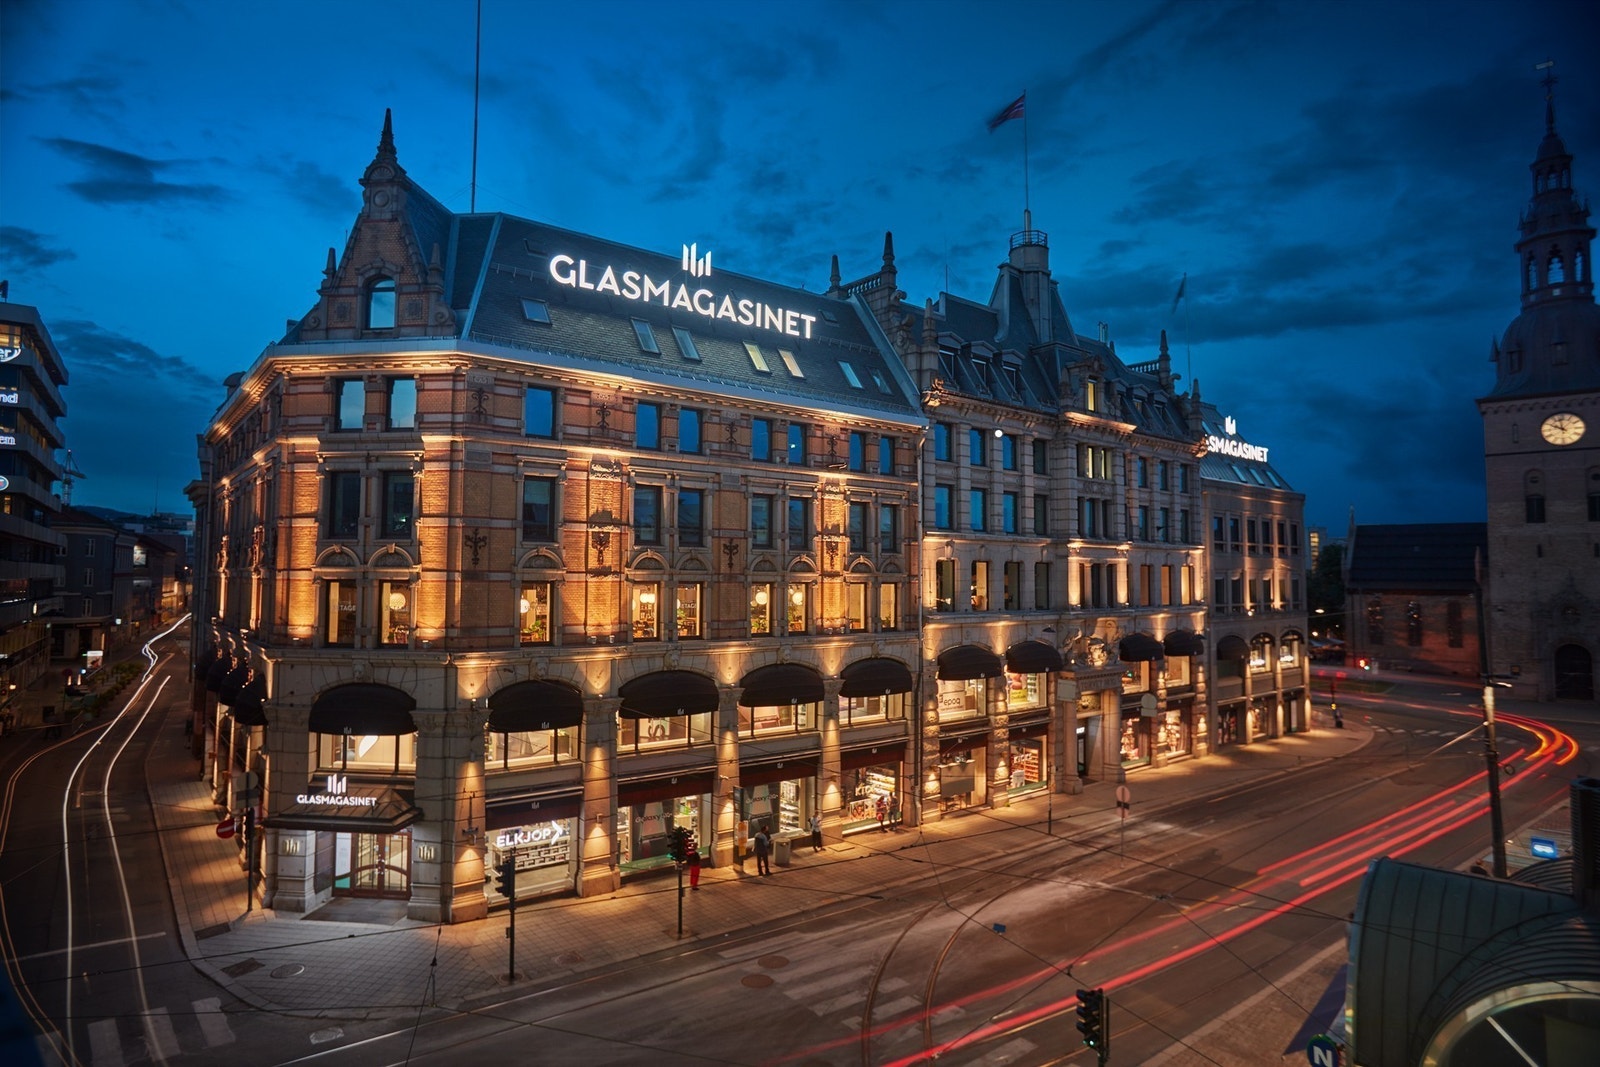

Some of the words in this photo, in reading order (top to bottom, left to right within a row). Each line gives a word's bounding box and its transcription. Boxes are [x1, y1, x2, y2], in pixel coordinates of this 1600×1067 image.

[548, 254, 817, 340] GLASMAGASINET
[296, 794, 378, 807] GLASMAGASINET
[1313, 1045, 1332, 1067] N
